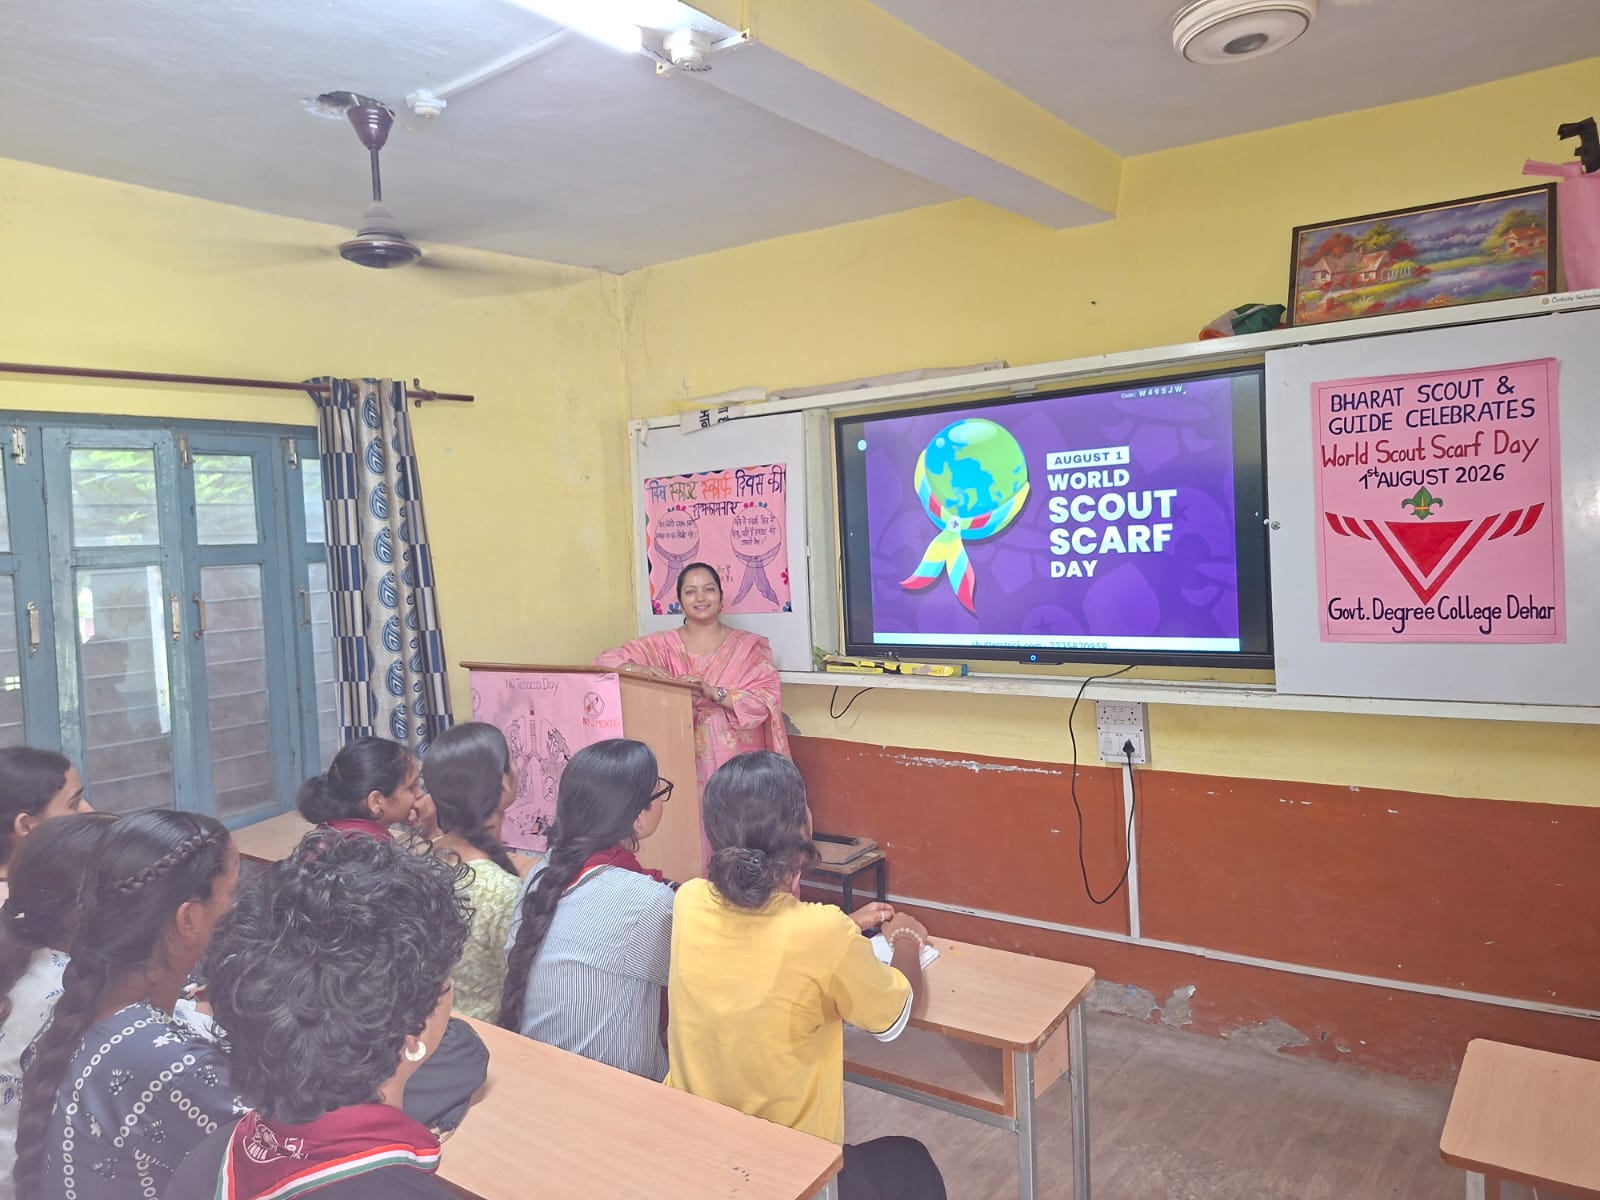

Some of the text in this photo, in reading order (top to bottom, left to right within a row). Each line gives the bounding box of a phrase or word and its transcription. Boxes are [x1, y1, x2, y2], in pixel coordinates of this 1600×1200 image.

[1330, 375, 1515, 412] BHARAT SCOUT &
[1328, 398, 1535, 435] GUIDE CELEBRATES
[1054, 451, 1123, 465] AUGUST 1
[1321, 429, 1540, 468] World Scout Scarf Day
[735, 469, 765, 497] दिवस
[768, 465, 785, 494] की
[1047, 469, 1130, 491] WORLD
[1455, 463, 1506, 483] 2026
[1048, 489, 1177, 524] SCOUT
[1049, 523, 1173, 555] SCARF
[1050, 560, 1098, 578] DAY
[1328, 594, 1555, 634] Govt. Degree College Dehar
[542, 678, 559, 696] Day
